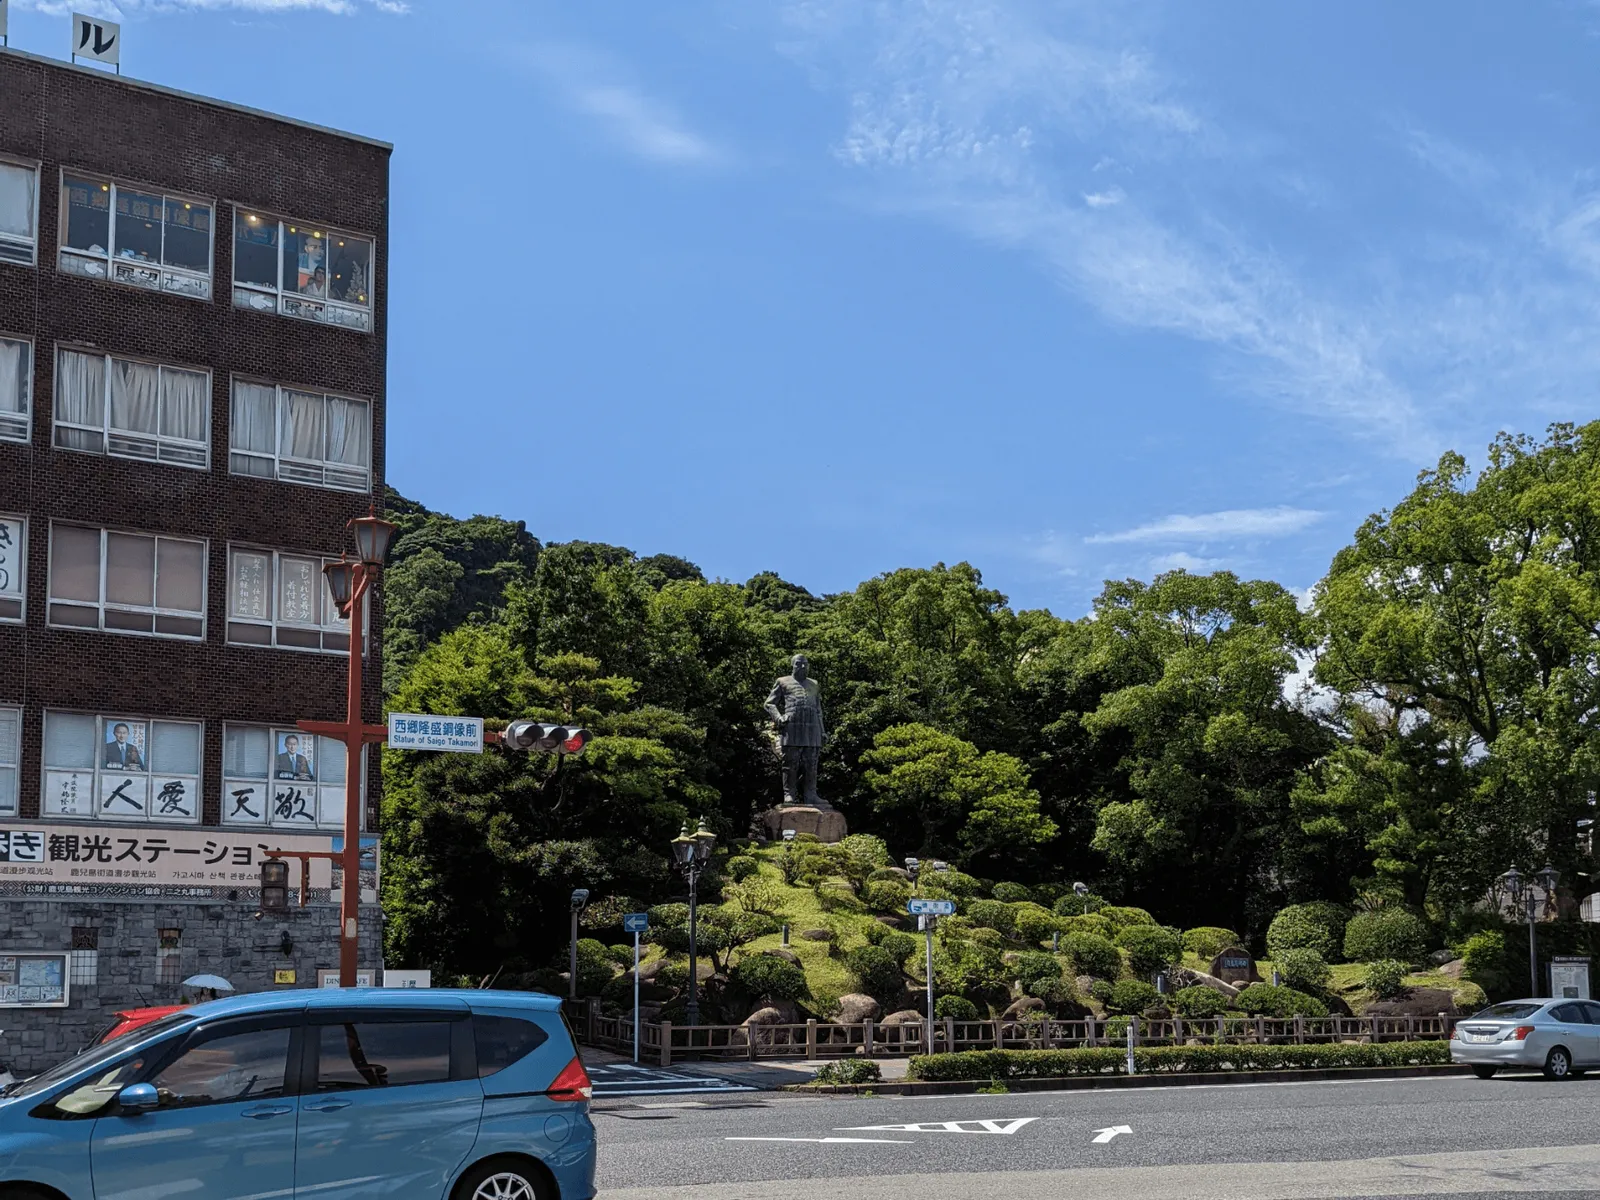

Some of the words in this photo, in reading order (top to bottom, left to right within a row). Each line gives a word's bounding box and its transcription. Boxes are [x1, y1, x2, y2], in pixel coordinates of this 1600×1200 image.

[79, 21, 115, 55] ル
[395, 719, 477, 738] 西郷隆盛銅像前
[393, 735, 415, 744] Statue
[427, 736, 446, 747] Saigo
[448, 738, 478, 748] Takamori
[172, 870, 205, 880] 가고시마
[209, 871, 226, 880] 산책
[230, 872, 262, 881] 관광스테
[325, 977, 340, 985] DIN
